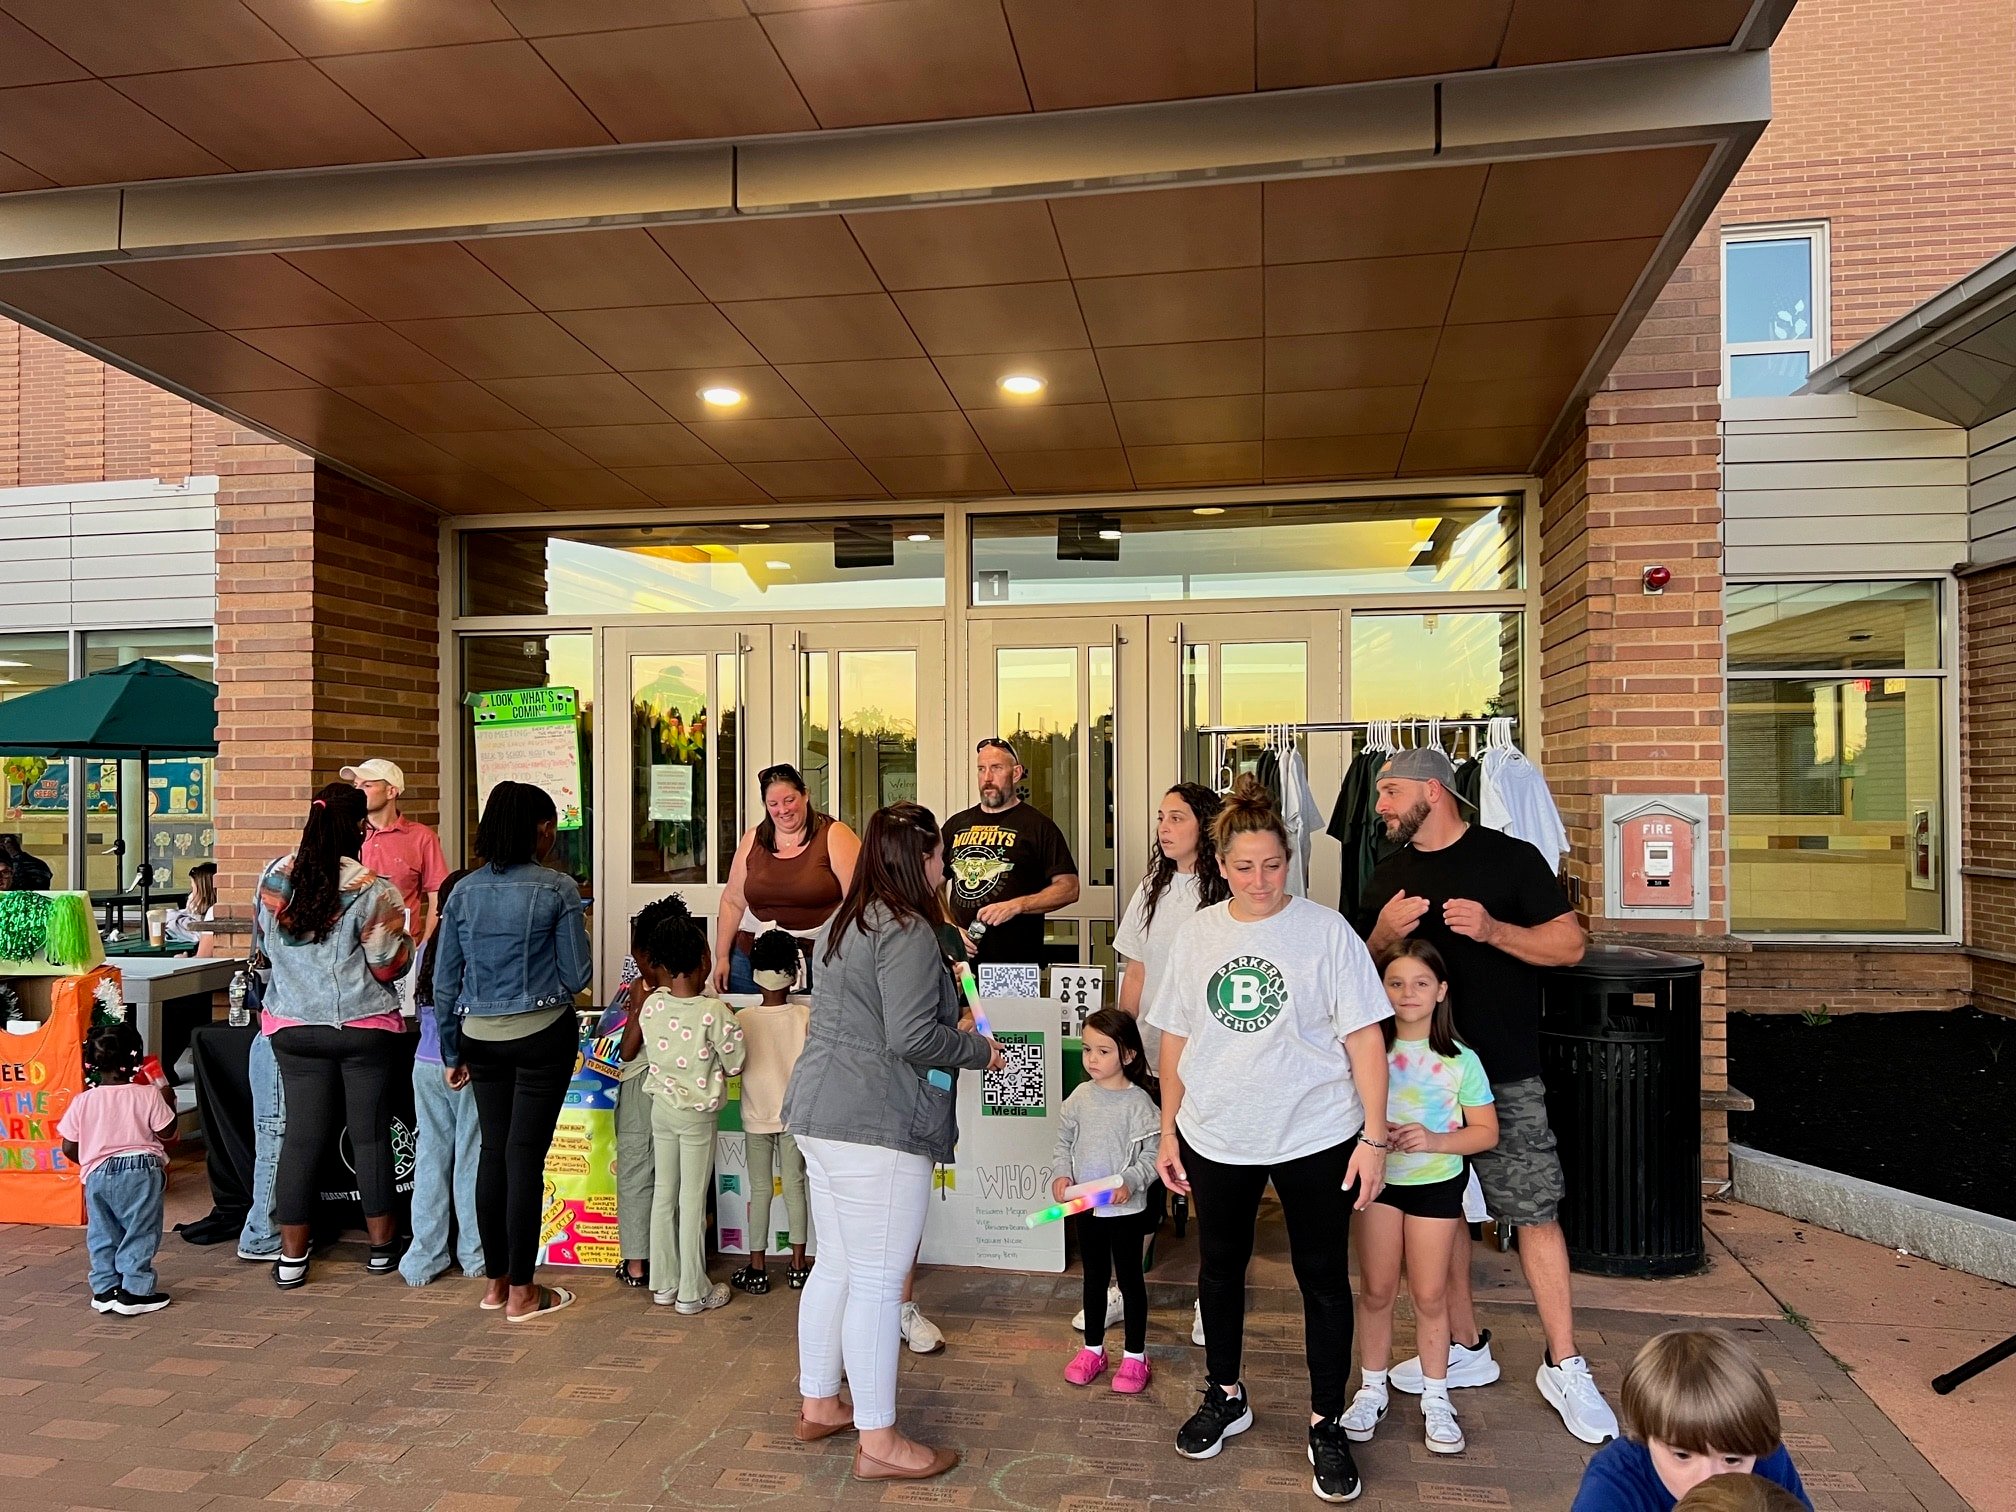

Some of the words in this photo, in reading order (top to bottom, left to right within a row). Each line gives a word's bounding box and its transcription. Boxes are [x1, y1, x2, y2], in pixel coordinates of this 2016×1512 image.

[988, 574, 999, 596] 1
[490, 693, 514, 707] LOOK
[520, 690, 554, 705] WHAT'S
[512, 704, 547, 719] COMING
[952, 831, 1017, 849] MURPHYS
[1642, 824, 1673, 835] FIRE
[1218, 957, 1278, 978] PARKER
[1229, 974, 1261, 1011] B
[1214, 1008, 1277, 1032] SCHOOL
[0, 1091, 49, 1115] THE
[992, 1105, 1028, 1116] Media
[976, 1164, 1053, 1201] WHO?
[541, 1227, 555, 1243] DAY
[556, 1217, 567, 1231] OCT
